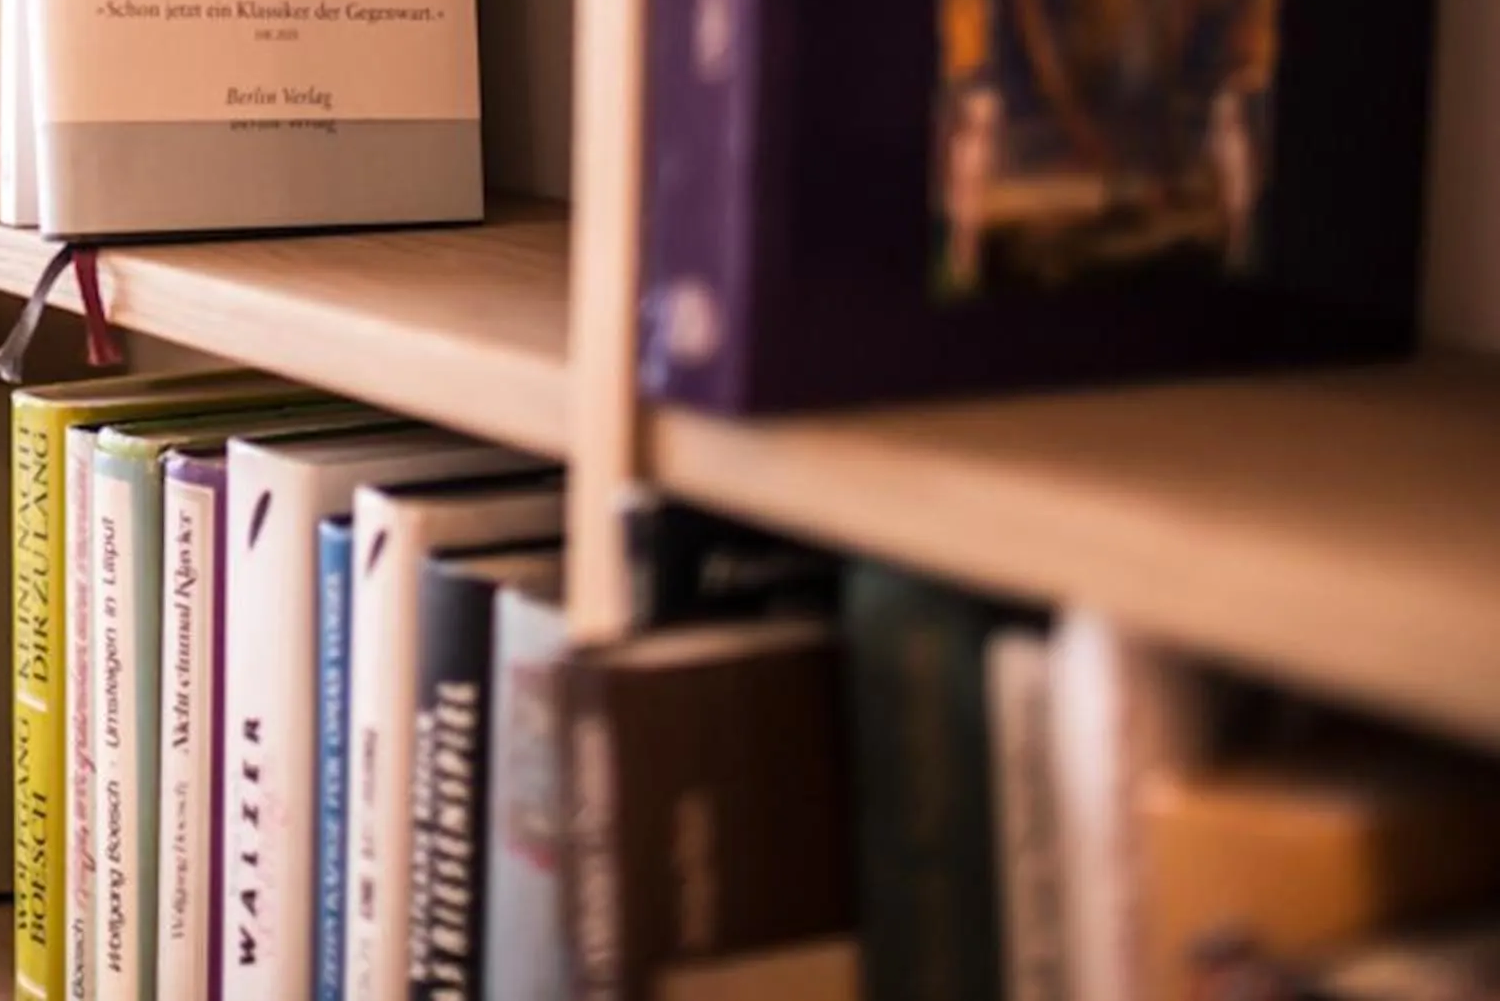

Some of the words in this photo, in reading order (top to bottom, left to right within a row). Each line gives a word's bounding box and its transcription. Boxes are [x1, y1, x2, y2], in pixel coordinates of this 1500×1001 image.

[164, 1, 203, 22] jetzt
[206, 2, 232, 19] ein
[236, 0, 310, 20] Klassiker
[314, 1, 340, 20] der
[225, 87, 277, 106] Berlin
[282, 86, 333, 110] Verlag
[16, 425, 33, 553] NACHT
[33, 430, 50, 542] LANG
[33, 549, 49, 606] ZU
[101, 517, 118, 586] Liliput
[173, 510, 199, 601] Klavier
[16, 569, 32, 681] KEINE
[32, 615, 49, 684] DIR
[104, 596, 118, 619] in
[174, 604, 191, 689] einmal
[103, 627, 123, 748] Umsteigen
[15, 715, 31, 931] WOLFGANG
[30, 790, 49, 947] BOESCH
[104, 780, 122, 862] Boesch
[238, 716, 261, 967] WALZER
[105, 868, 124, 973] Wolfgang
